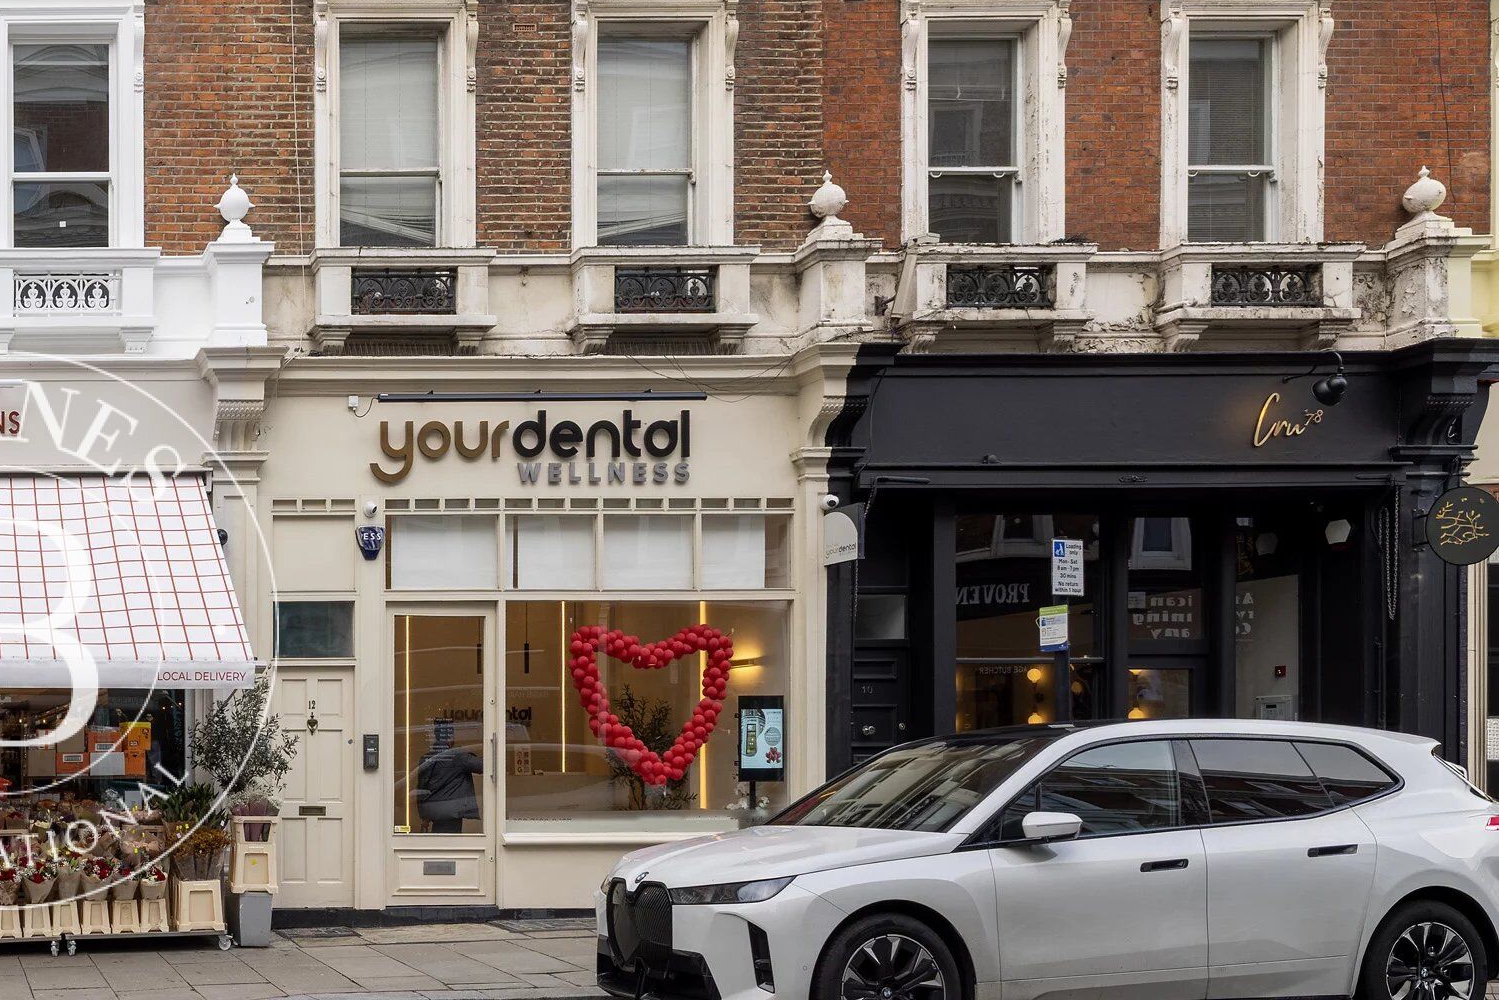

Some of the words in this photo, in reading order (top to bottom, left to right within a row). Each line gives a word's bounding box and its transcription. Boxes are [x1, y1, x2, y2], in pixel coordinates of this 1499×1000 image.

[1253, 392, 1307, 447] Cru
[369, 409, 691, 484] yourdental
[517, 462, 691, 483] WELLNESS
[363, 532, 382, 541] ESS
[157, 671, 192, 681] LOCAL
[195, 671, 247, 681] DELIVERY
[308, 700, 316, 710] 12
